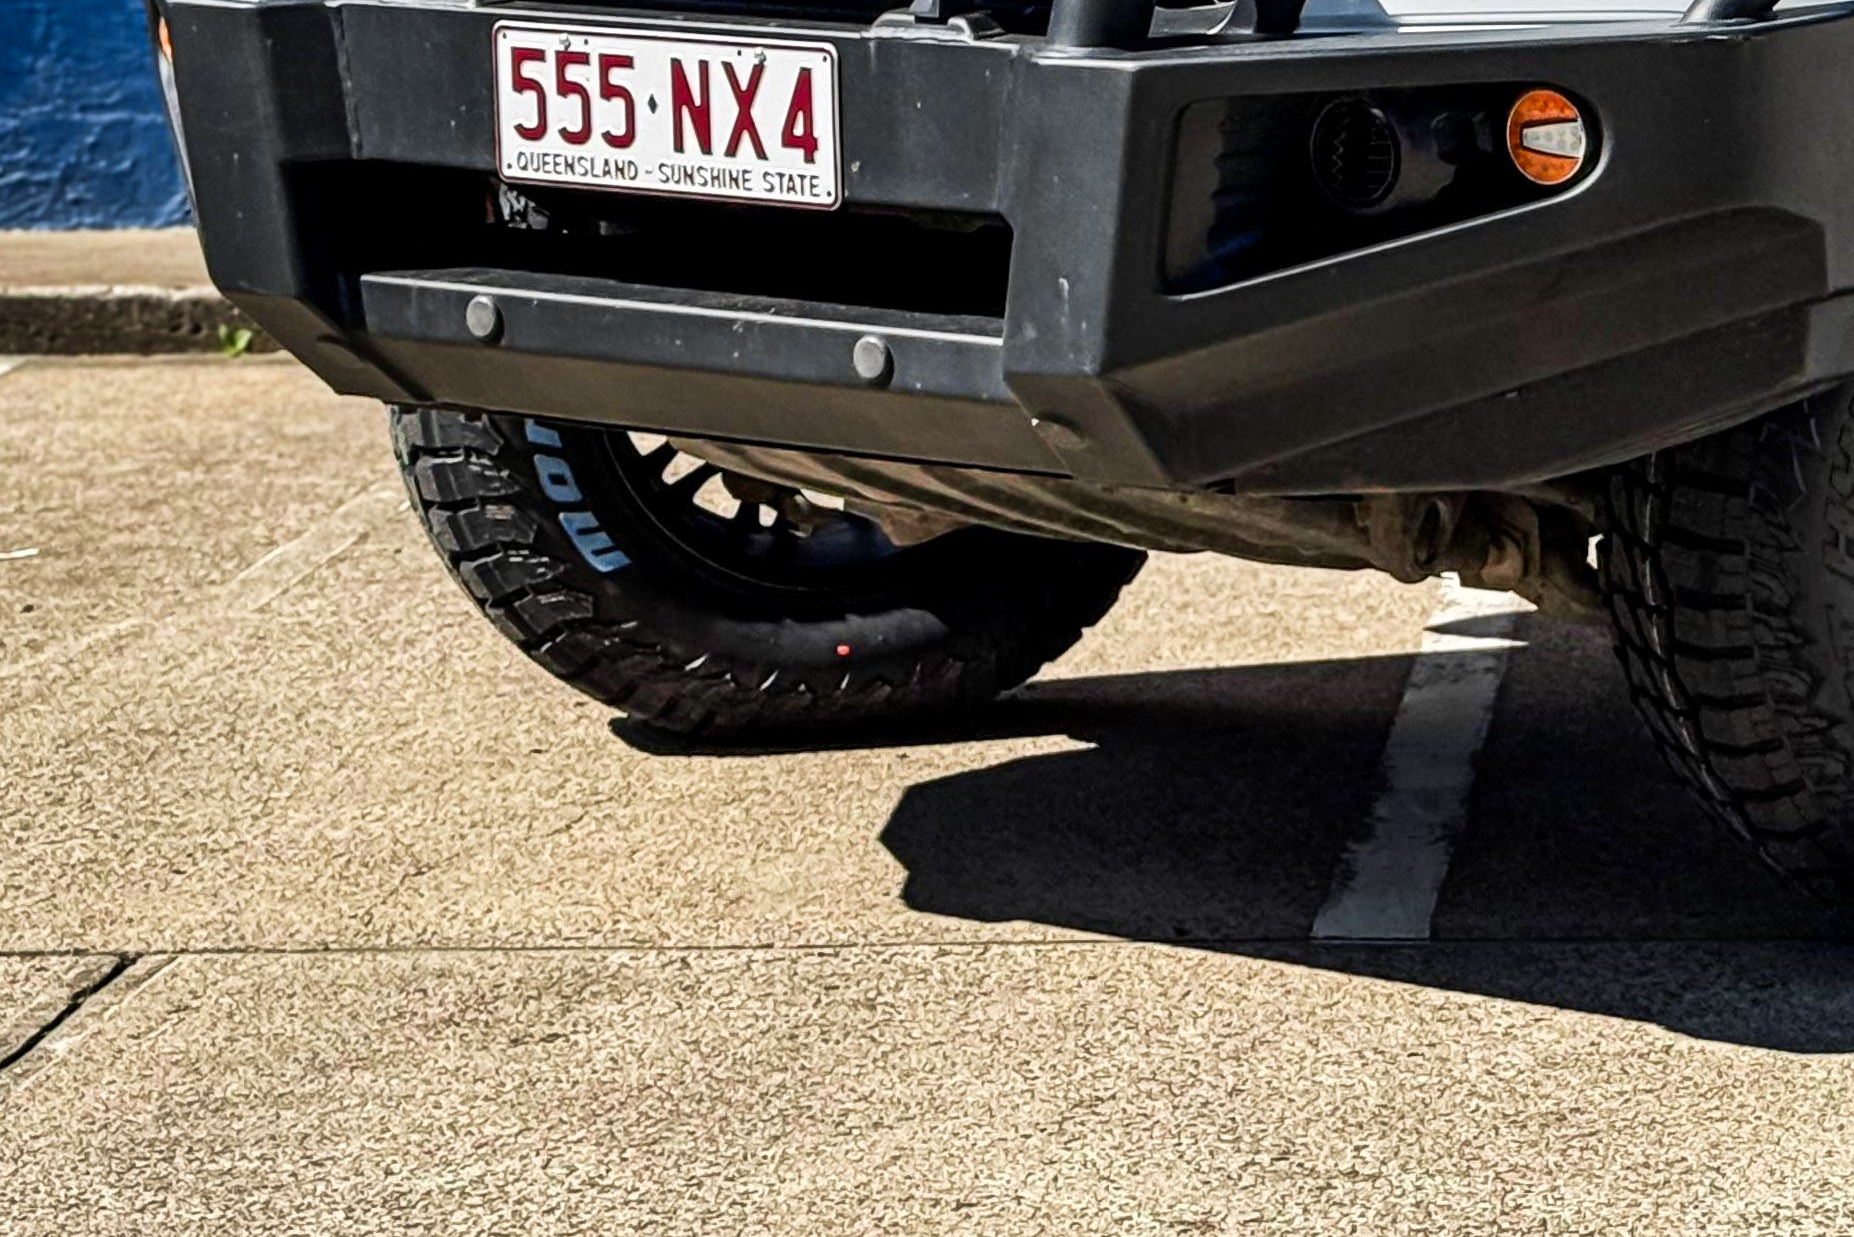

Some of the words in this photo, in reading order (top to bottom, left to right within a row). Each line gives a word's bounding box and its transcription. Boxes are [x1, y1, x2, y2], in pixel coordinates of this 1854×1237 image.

[516, 151, 639, 181] QUEENSLAND
[658, 163, 754, 192] SUNSHINE
[762, 172, 821, 197] STATE
